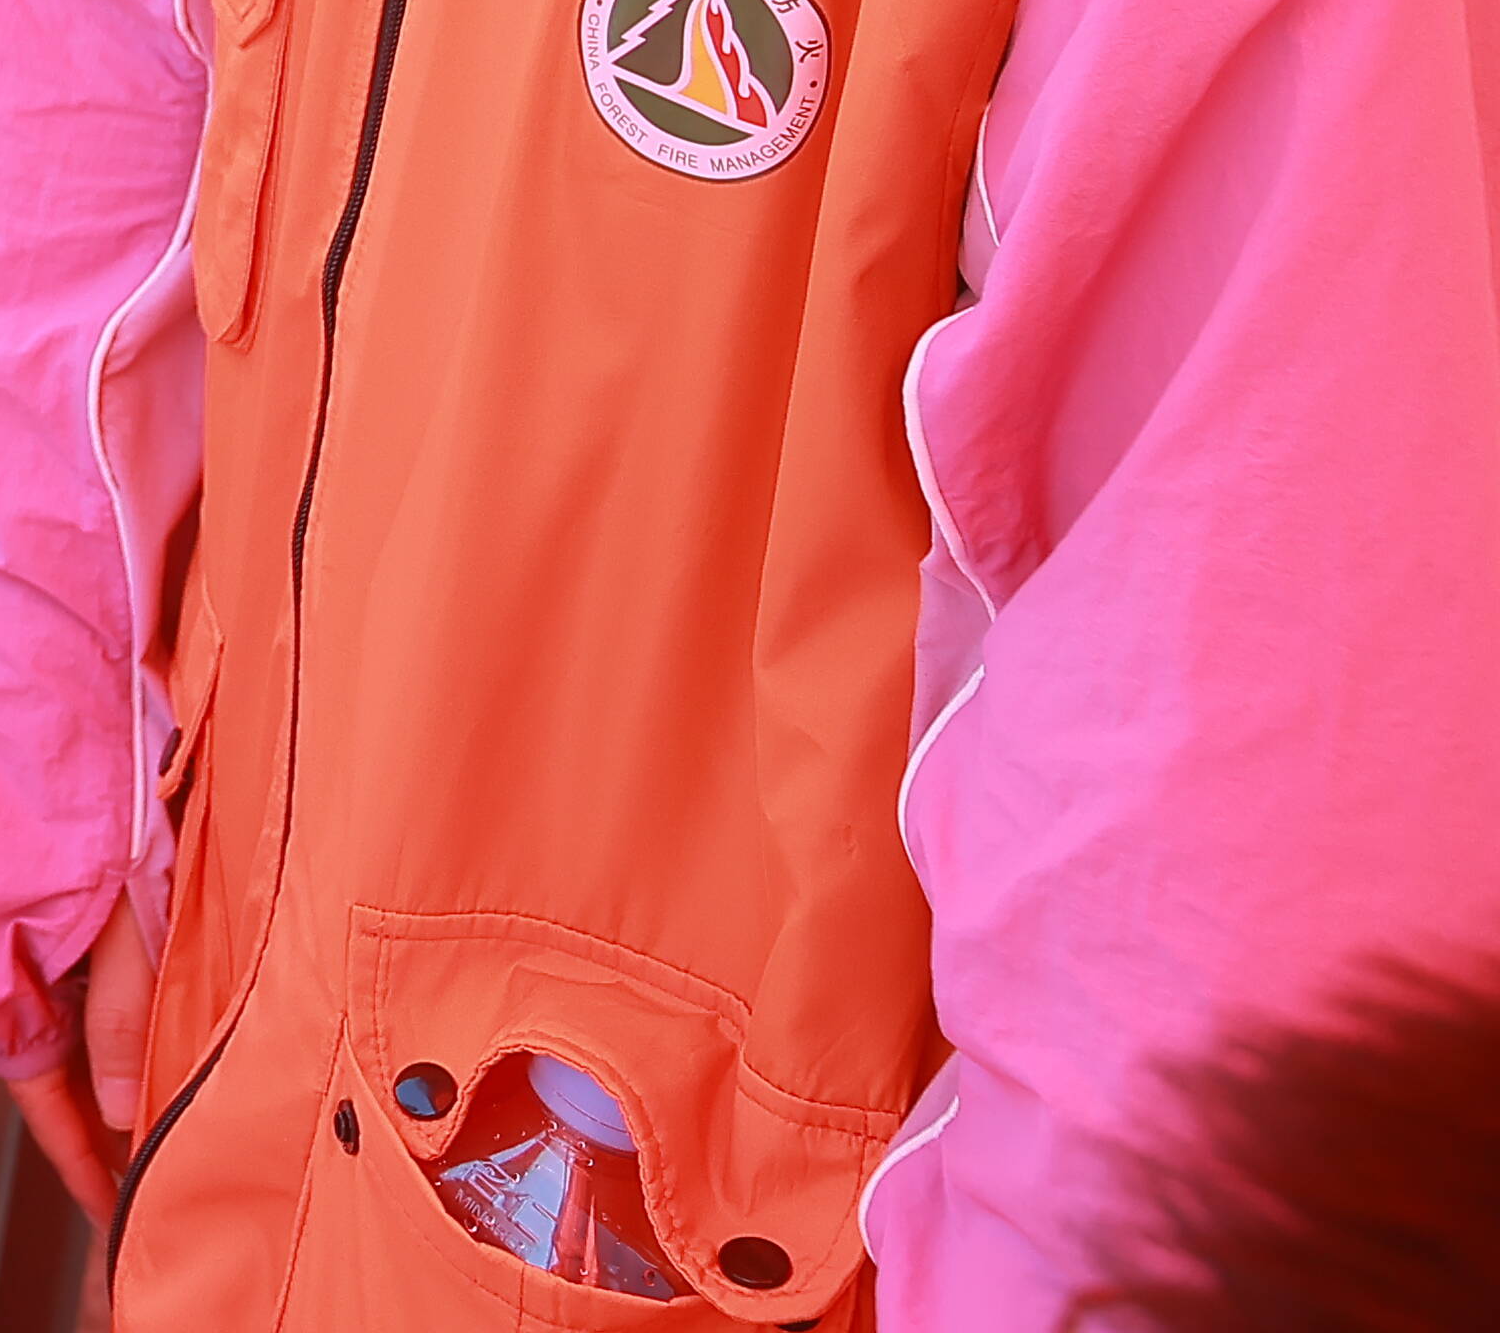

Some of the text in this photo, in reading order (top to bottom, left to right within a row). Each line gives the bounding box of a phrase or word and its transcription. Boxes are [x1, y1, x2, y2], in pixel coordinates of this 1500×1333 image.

[587, 13, 817, 173] CHINA FOREST FIRE MANAGEMENT
